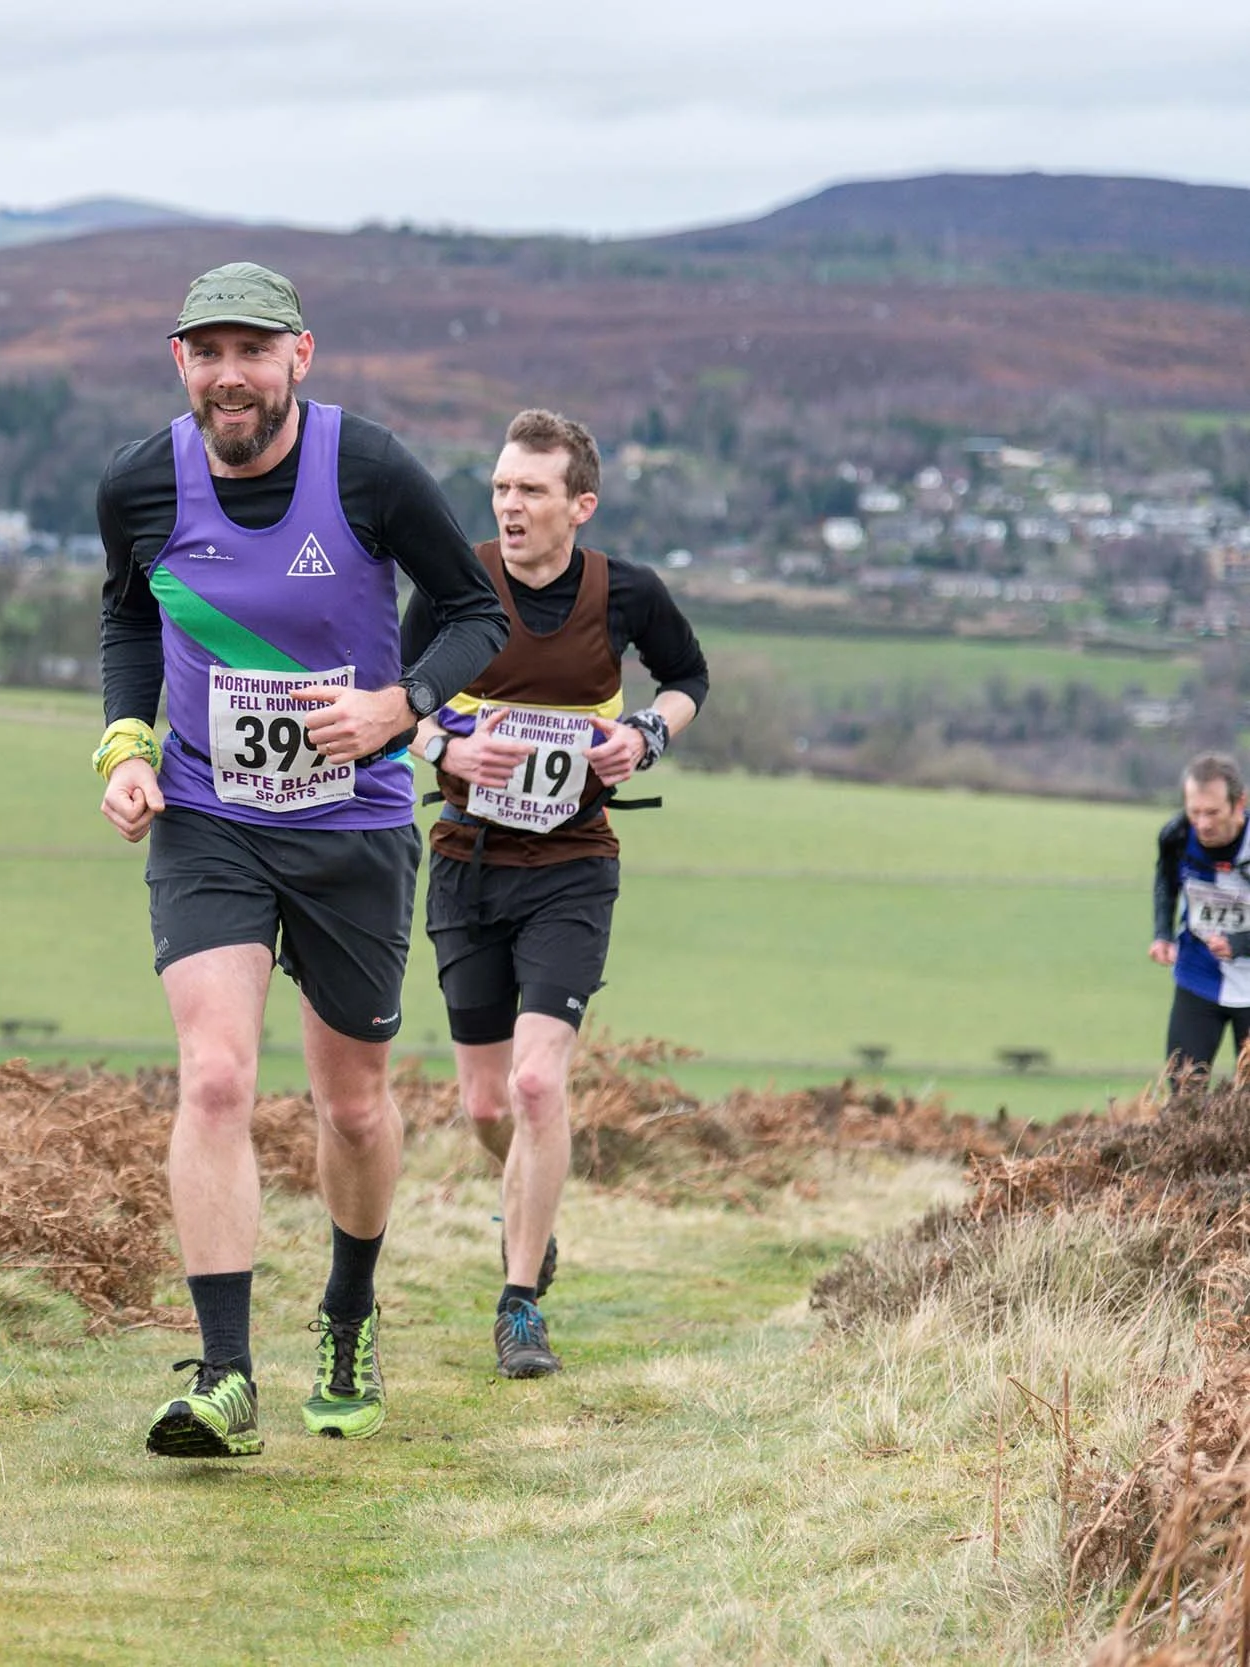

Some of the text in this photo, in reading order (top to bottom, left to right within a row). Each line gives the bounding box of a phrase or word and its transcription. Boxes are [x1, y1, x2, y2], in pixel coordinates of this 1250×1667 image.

[230, 695, 331, 712] FELL RUNNER
[480, 708, 590, 731] NTHUMBERLAND
[520, 727, 576, 745] RUNNERS
[222, 766, 351, 791] PETE BLAND
[505, 746, 572, 798] 19
[255, 786, 317, 804] SPORTS
[475, 785, 576, 816] PETE BLAND
[497, 808, 549, 826] SPORTS
[1201, 905, 1245, 926] 475
